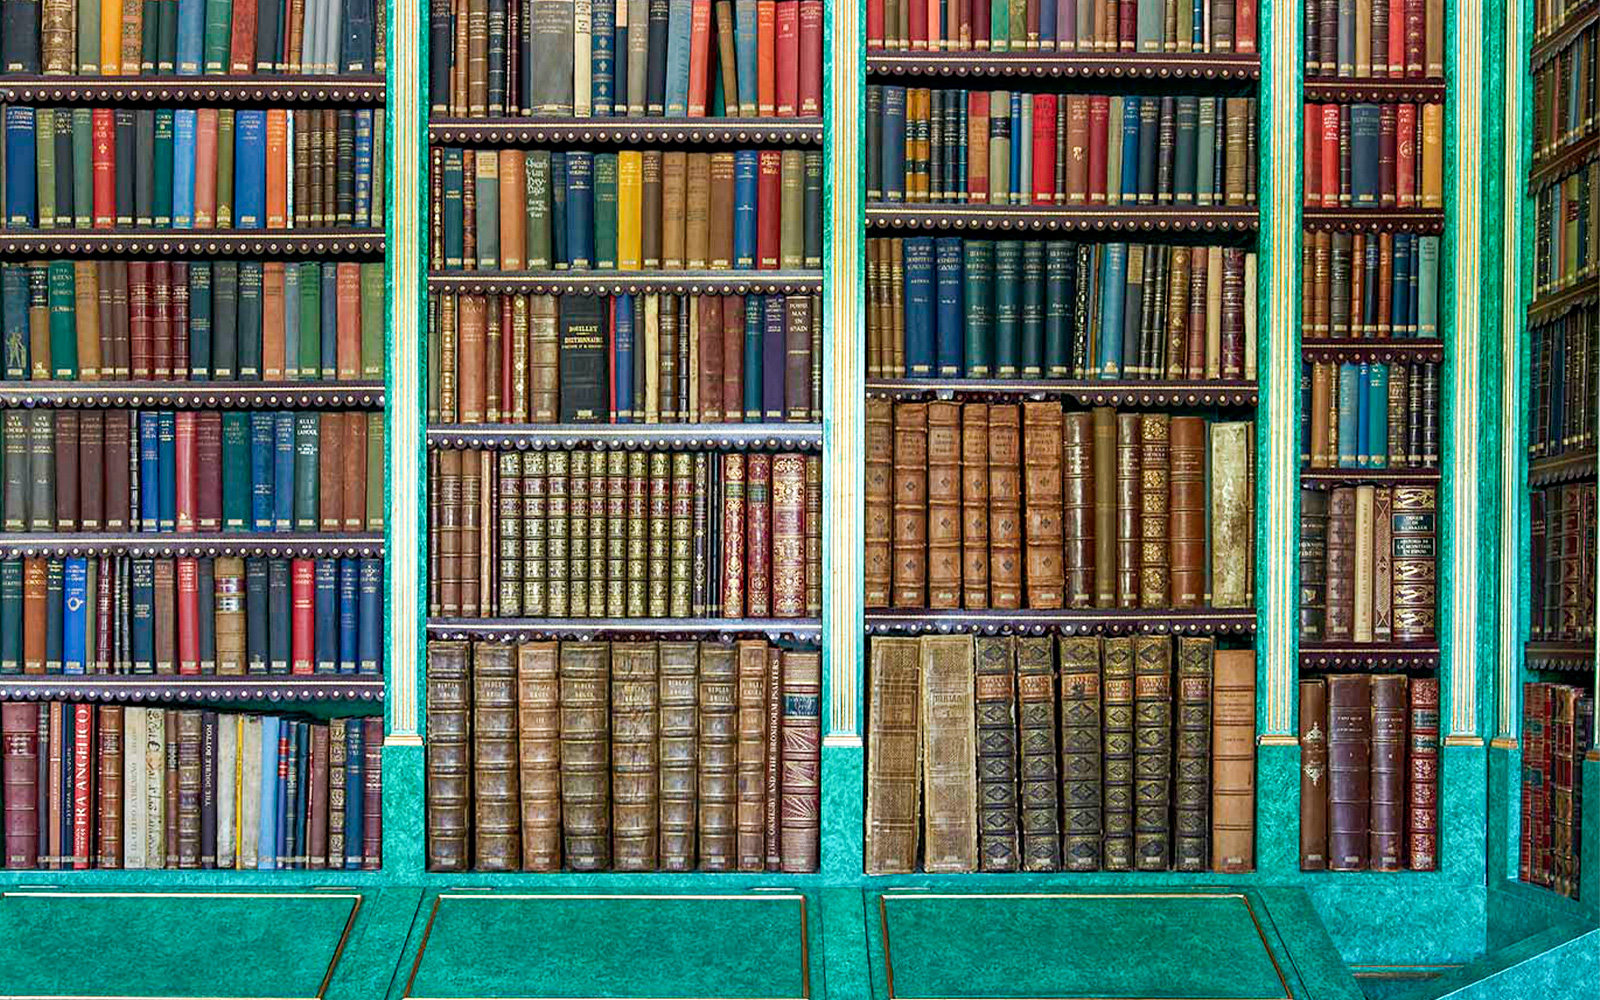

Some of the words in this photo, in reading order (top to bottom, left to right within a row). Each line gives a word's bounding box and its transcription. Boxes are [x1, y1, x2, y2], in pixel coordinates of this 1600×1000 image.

[75, 707, 88, 790] ANGELICO
[205, 724, 213, 756] BOTTOM
[76, 796, 87, 825] FRA
